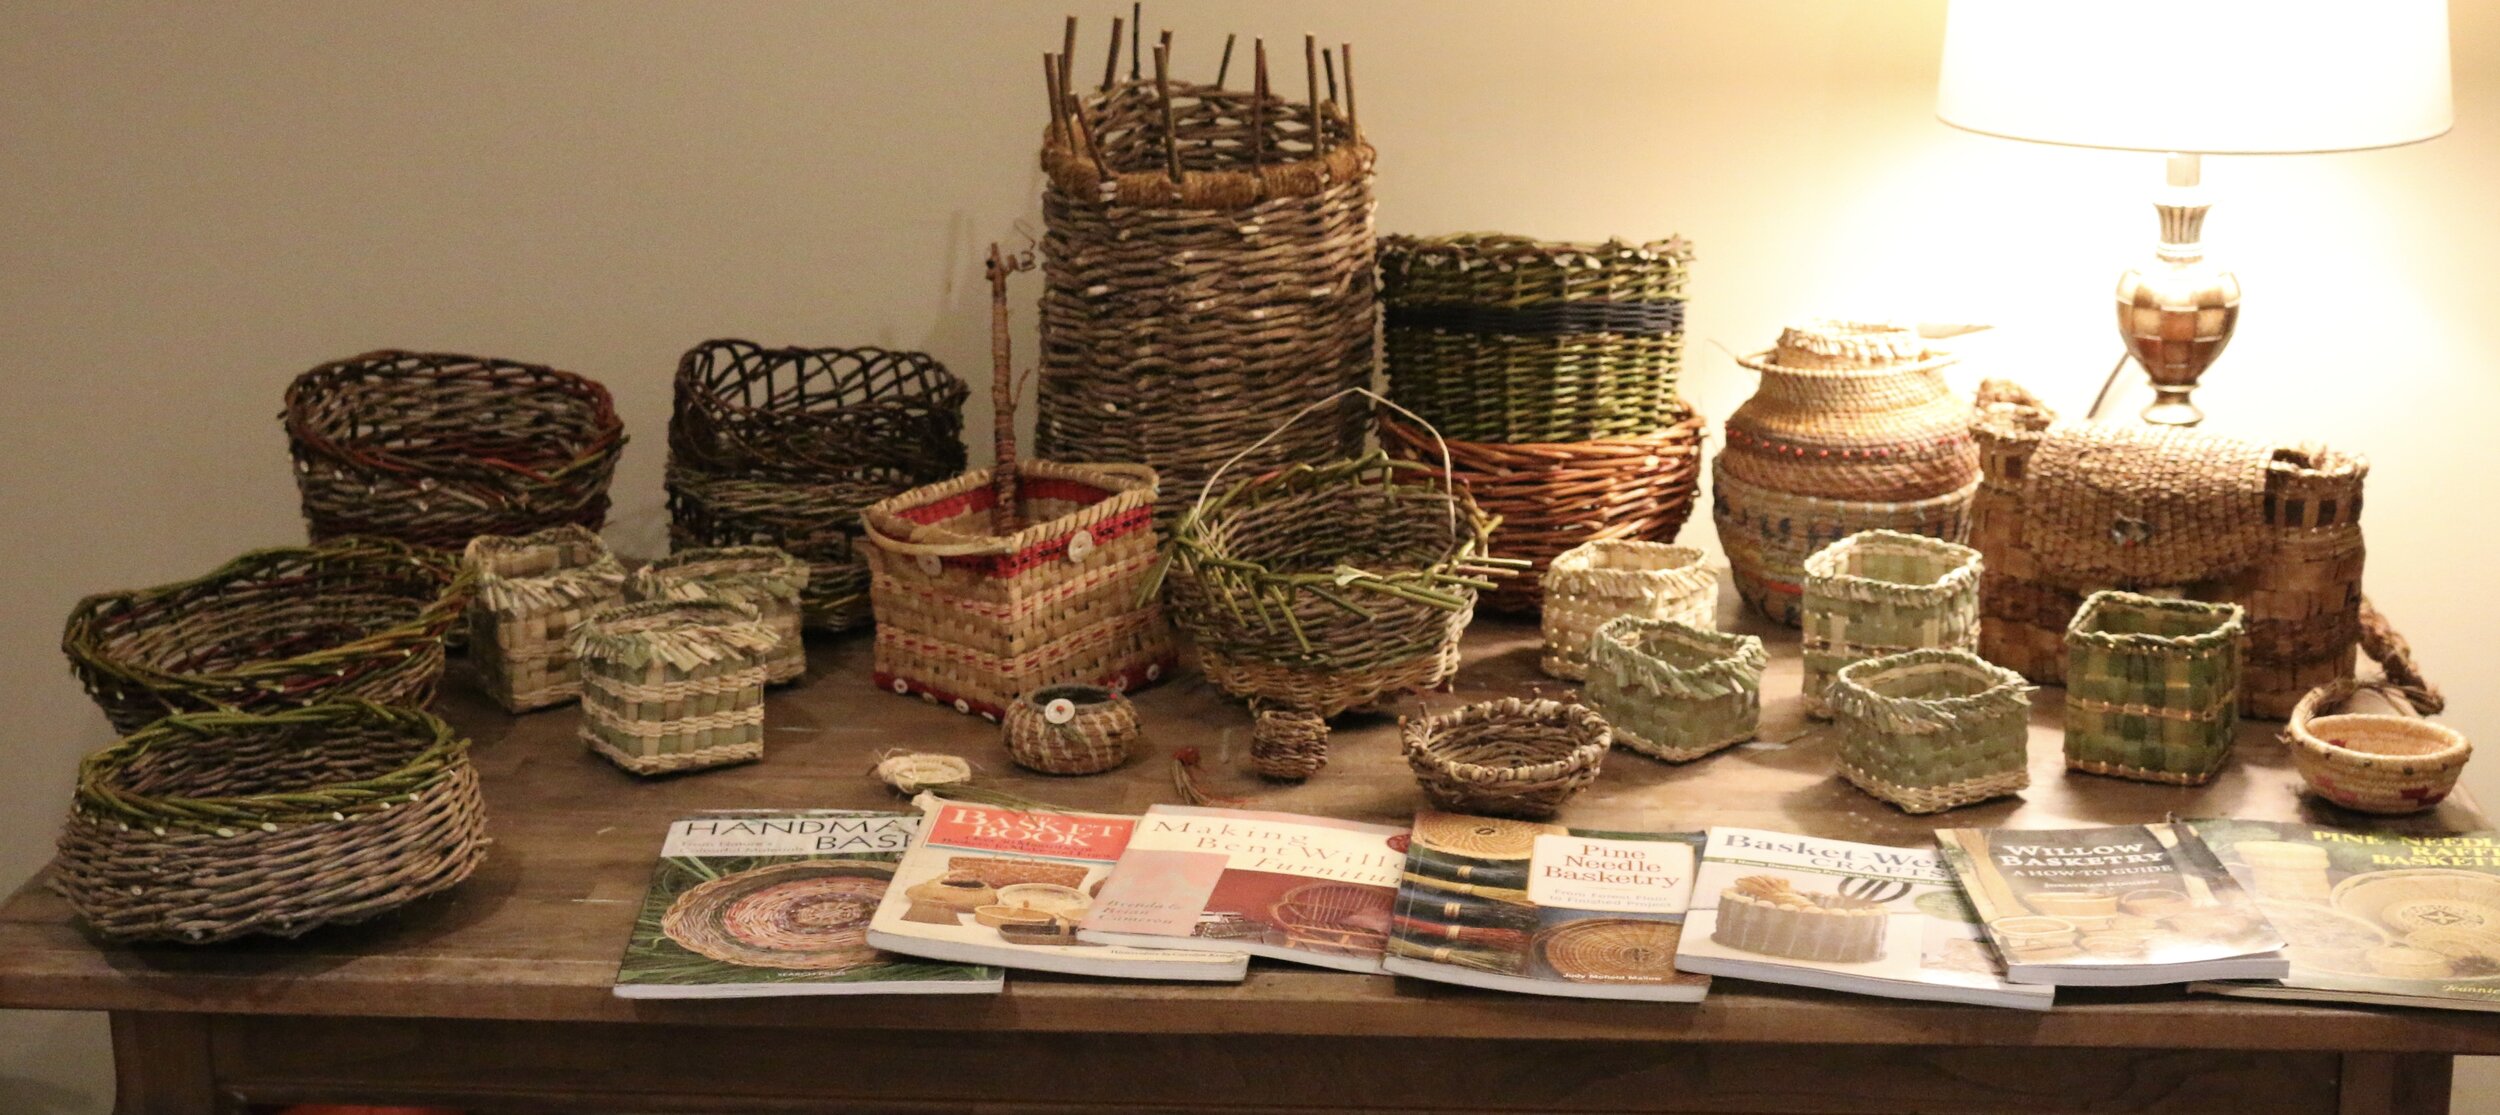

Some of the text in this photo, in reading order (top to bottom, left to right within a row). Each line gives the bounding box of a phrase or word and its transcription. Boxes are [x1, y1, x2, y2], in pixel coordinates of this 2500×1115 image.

[951, 809, 1123, 837] BASKET
[973, 825, 1091, 845] BOOK
[1154, 822, 1308, 845] Making
[2312, 831, 2386, 845] PINE
[1196, 837, 1287, 857] Bent
[1583, 845, 1645, 859] Pine
[2003, 844, 2143, 856] WILLOW
[2412, 847, 2500, 857] RAFFI
[1565, 855, 1661, 873] Needle
[1811, 859, 1945, 878] CRAFTS
[2000, 853, 2163, 866] BASKETRY
[1545, 866, 1679, 888] Basketry
[2111, 864, 2174, 874] GUIDE
